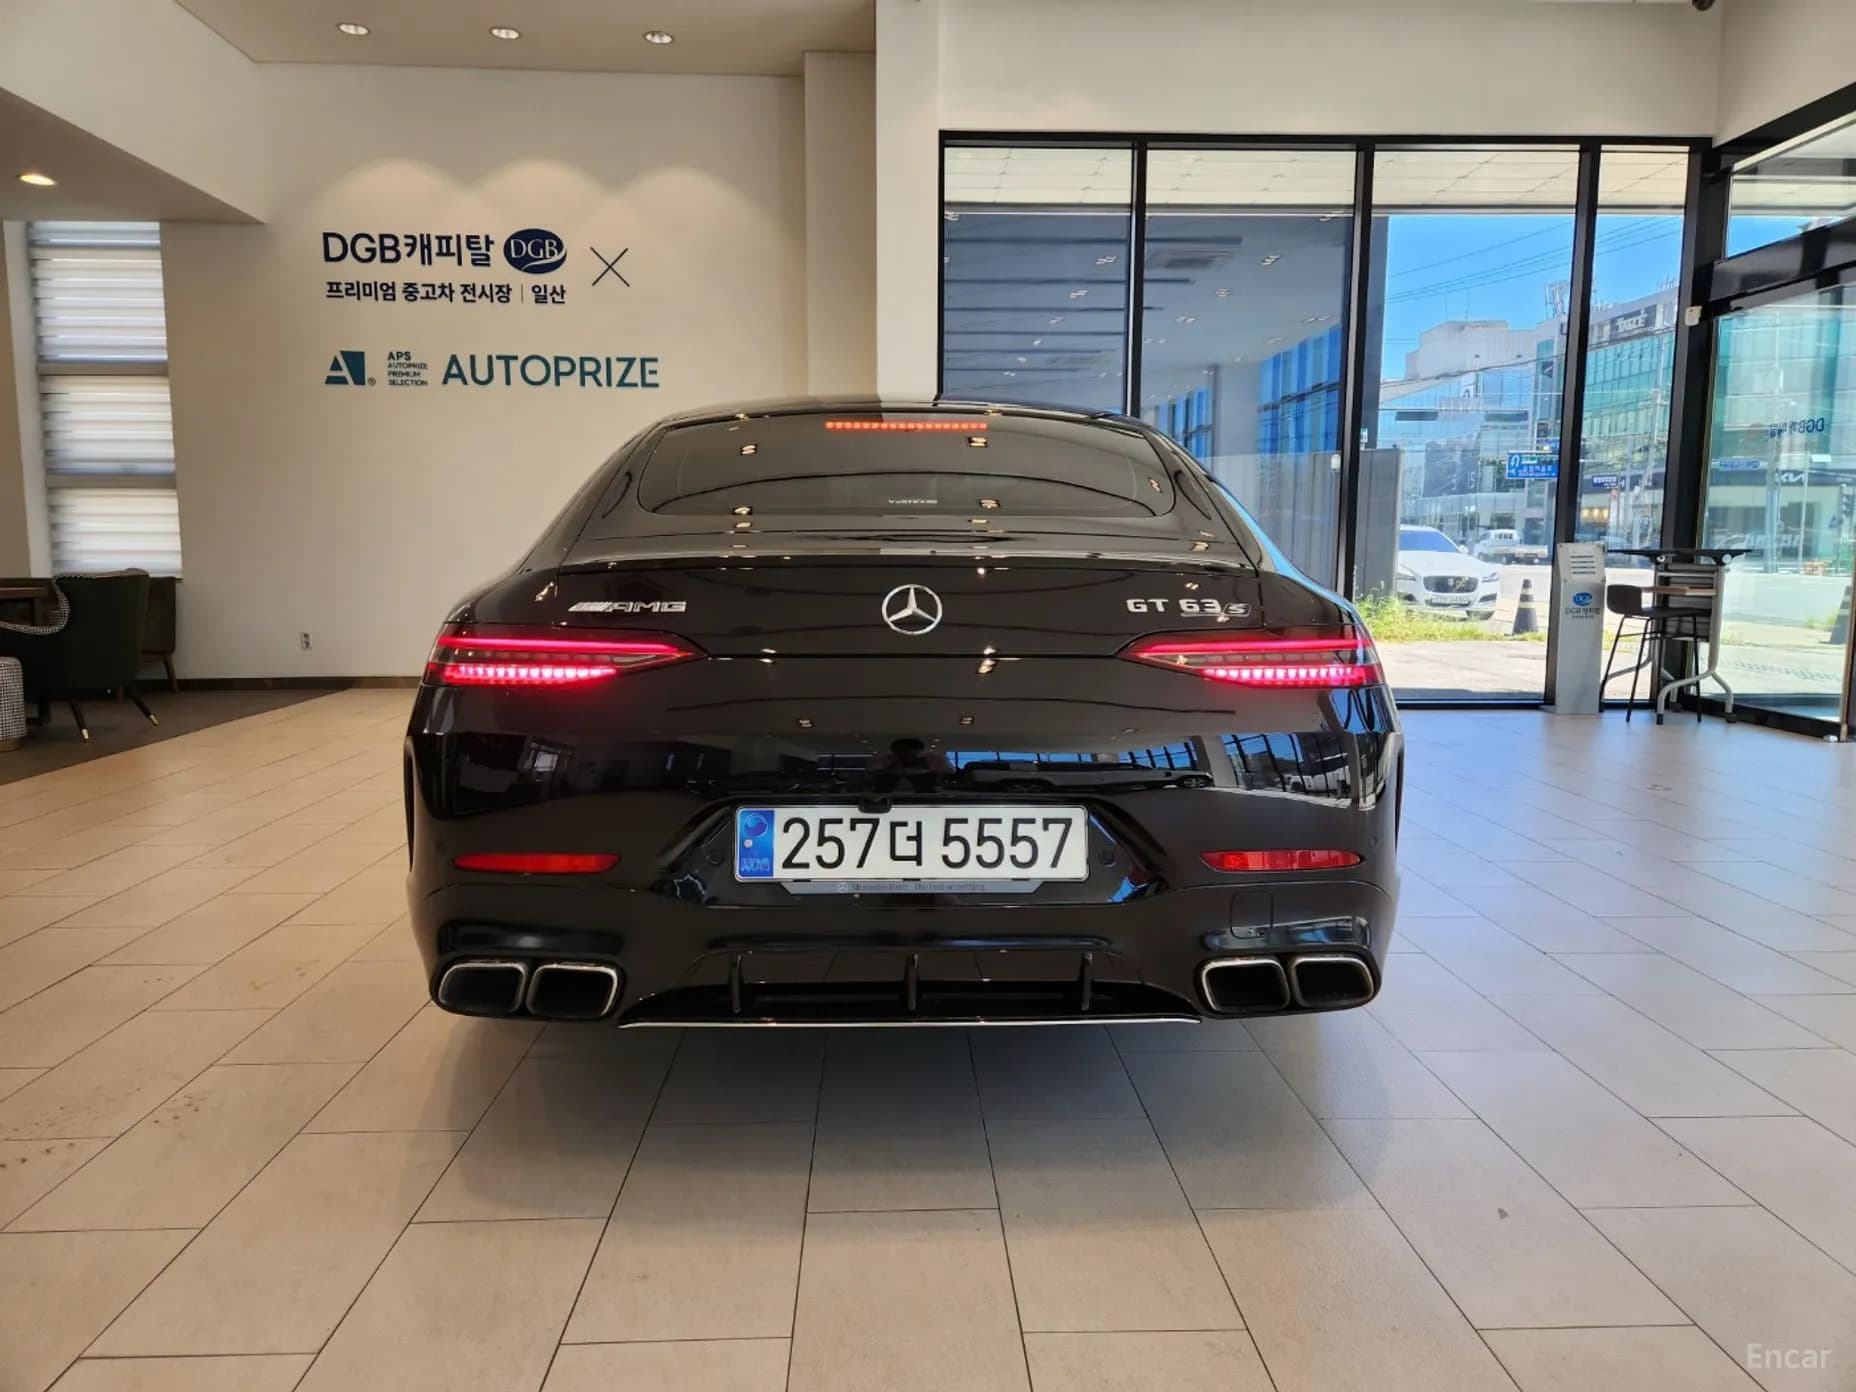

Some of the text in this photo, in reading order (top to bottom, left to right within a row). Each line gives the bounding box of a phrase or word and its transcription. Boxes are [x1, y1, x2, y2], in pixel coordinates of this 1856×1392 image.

[322, 231, 495, 267] DGB캐피탈
[509, 238, 561, 260] DGB
[326, 281, 567, 305] 프리미엄 중고차 전시장 일산
[387, 351, 411, 361] APS
[441, 353, 660, 389] AUTOPRIZE
[388, 378, 428, 387] SELECTION
[602, 601, 687, 613] AMG
[1126, 598, 1169, 613] GT
[1178, 598, 1222, 614] 63
[782, 817, 1073, 869] 257더 5557
